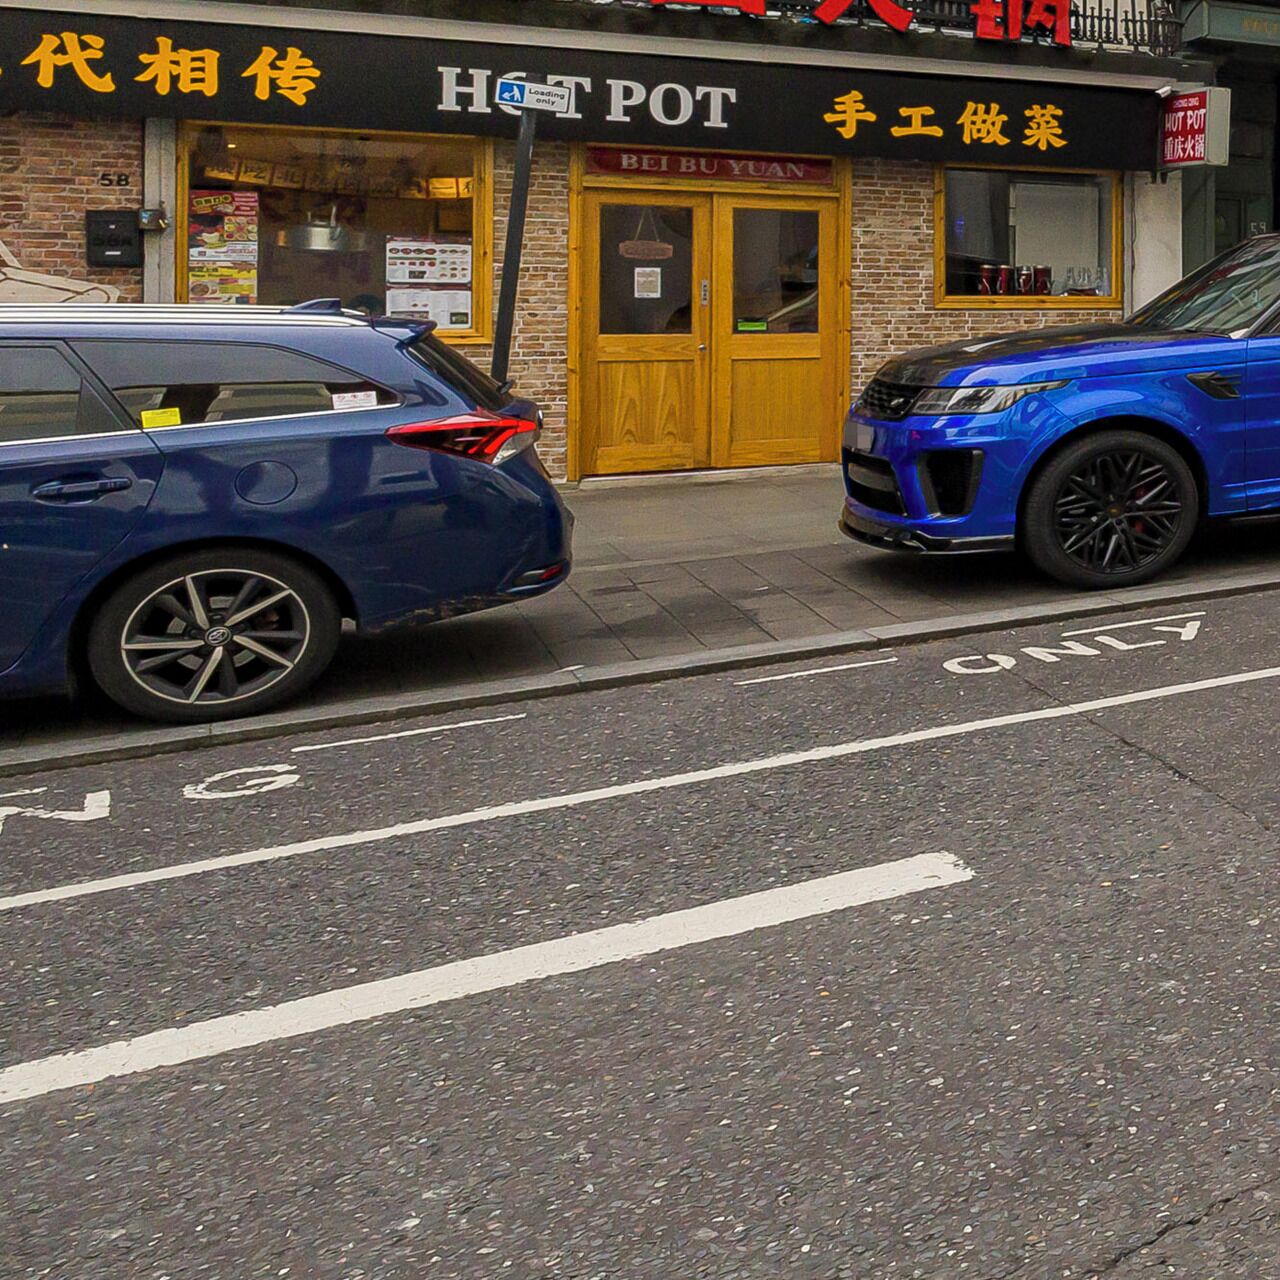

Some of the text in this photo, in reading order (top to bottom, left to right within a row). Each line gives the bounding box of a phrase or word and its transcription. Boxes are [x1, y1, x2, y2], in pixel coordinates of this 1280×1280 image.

[0, 31, 322, 106] 代相传
[529, 88, 565, 100] Loading
[536, 98, 556, 106] only
[605, 78, 737, 128] POT
[823, 90, 1068, 150] 手工做菜
[1165, 108, 1206, 133] HOT POT
[620, 153, 804, 178] BEI BU YUAN
[100, 173, 130, 186] 58
[943, 621, 1201, 674] ONLY
